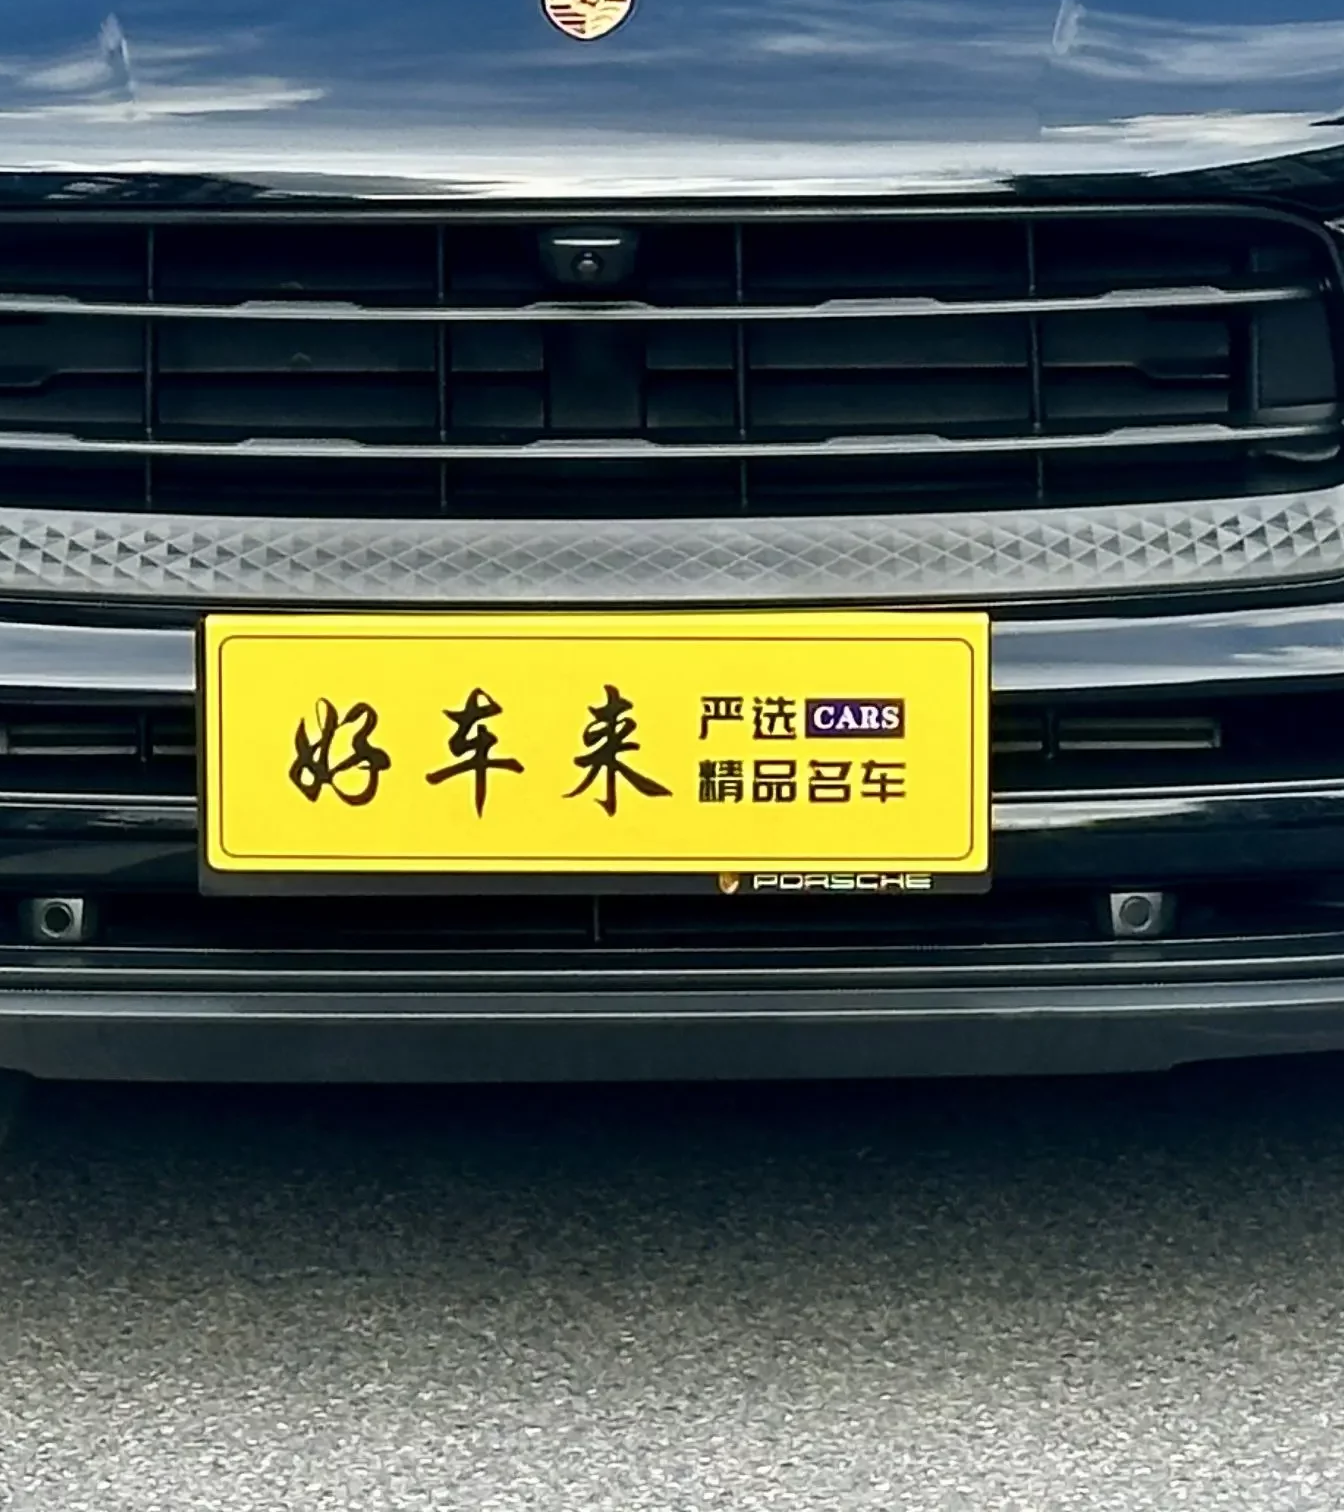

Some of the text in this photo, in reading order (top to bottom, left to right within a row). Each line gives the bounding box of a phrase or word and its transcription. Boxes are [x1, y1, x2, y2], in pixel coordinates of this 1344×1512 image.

[698, 696, 900, 740] 严选 CARS
[289, 684, 674, 820] 好车来
[698, 759, 907, 804] 精品名车
[752, 873, 932, 890] PORSCHE
